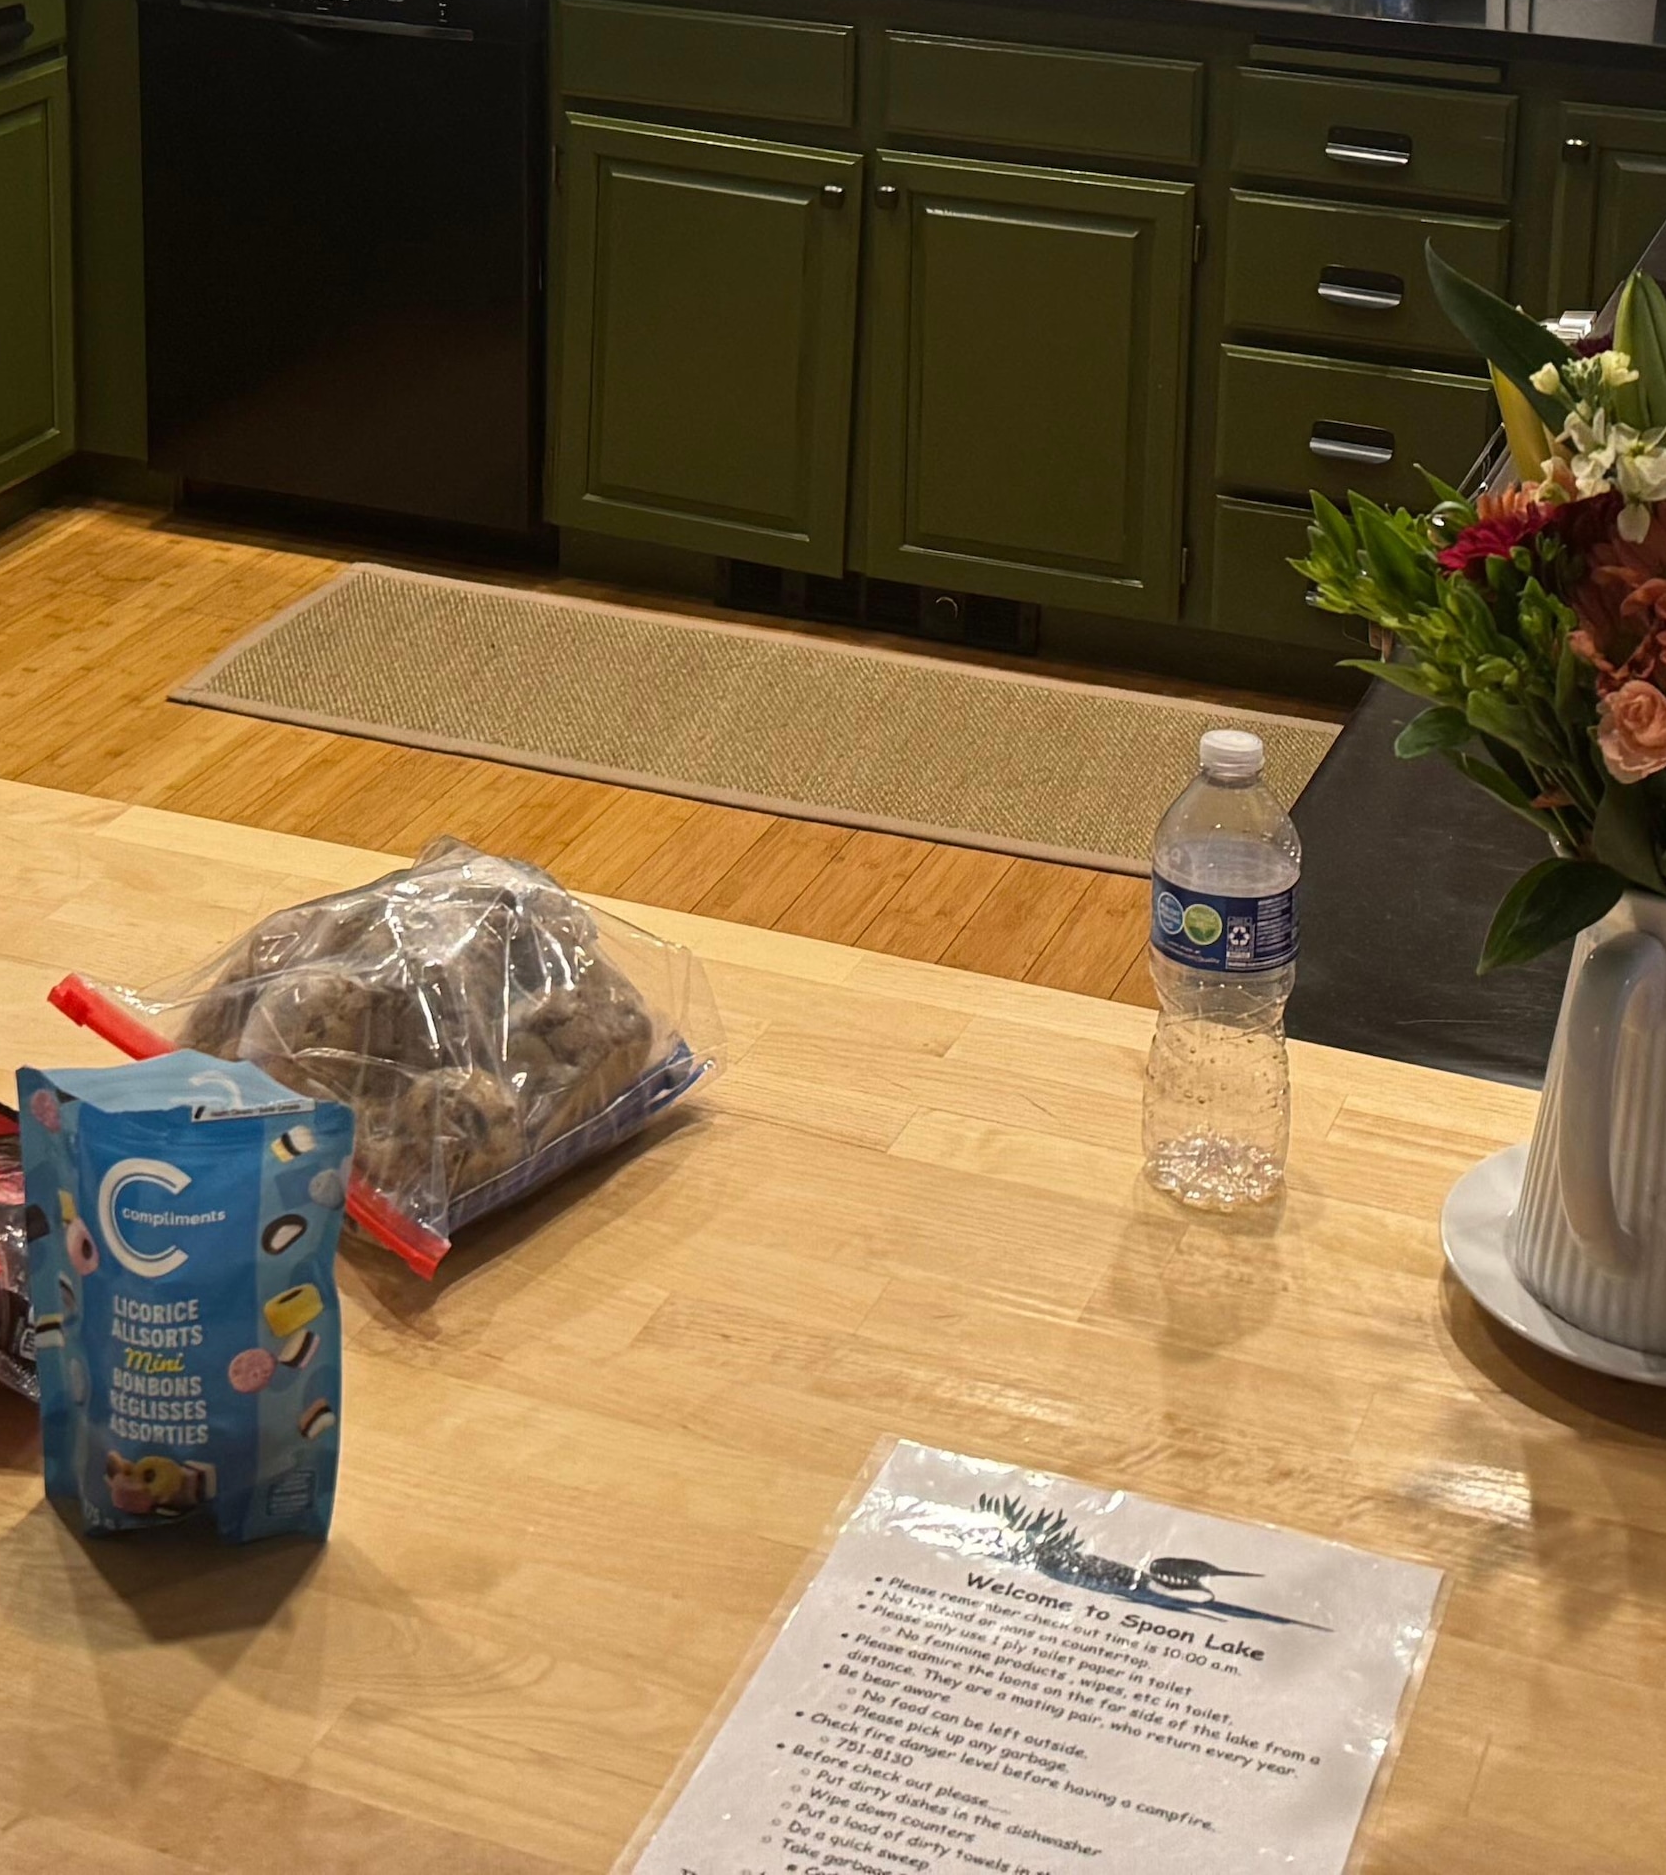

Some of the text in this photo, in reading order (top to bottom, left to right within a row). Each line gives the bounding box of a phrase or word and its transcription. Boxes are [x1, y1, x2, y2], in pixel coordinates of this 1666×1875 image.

[98, 1157, 193, 1279] C
[121, 1205, 227, 1228] compliments
[111, 1316, 204, 1348] ALLSORTS
[113, 1294, 200, 1324] LICORICE
[113, 1367, 203, 1397] BONBONS
[125, 1347, 186, 1374] Mini
[110, 1412, 210, 1445] ASSORTIES
[879, 1589, 903, 1605] No
[976, 1617, 997, 1627] or
[887, 1576, 937, 1598] Please
[1071, 1624, 1101, 1638] out
[1104, 1631, 1139, 1649] time
[1142, 1640, 1159, 1654] is
[966, 1572, 1265, 1661] Welcome to Spoon Lake
[870, 1603, 921, 1625] Please
[922, 1620, 957, 1634] only
[958, 1628, 986, 1643] use
[1001, 1639, 1027, 1653] ply
[1031, 1646, 1076, 1665] toilet
[1076, 1659, 1125, 1678] paper
[1127, 1670, 1144, 1684] in
[1147, 1676, 1193, 1696] toilet
[894, 1626, 920, 1642] No
[923, 1634, 991, 1661] feminine
[993, 1654, 1067, 1681] products
[1131, 1691, 1161, 1706] etc
[1163, 1697, 1180, 1711] in
[836, 1663, 951, 1703] Be bear aware
[853, 1632, 1321, 1766] Please admire the loons on the far side of the lake from a
[851, 1703, 904, 1728] Please
[905, 1721, 942, 1738] pick
[944, 1731, 965, 1745] up
[966, 1738, 997, 1754] any
[861, 1688, 886, 1704] No
[889, 1696, 930, 1716] food
[929, 1709, 960, 1724] can
[961, 1715, 984, 1731] be
[986, 1721, 1021, 1740] left
[924, 1667, 963, 1689] They
[963, 1682, 993, 1697] are
[994, 1690, 1007, 1701] a
[1009, 1694, 1065, 1717] mating
[1108, 1721, 1142, 1737] who
[1145, 1731, 1201, 1753] return
[1204, 1747, 1253, 1767] every
[790, 1743, 933, 1792] Before check out
[809, 1711, 860, 1734] Check
[862, 1726, 896, 1744] fire
[898, 1737, 956, 1759] danger
[958, 1751, 999, 1772] level
[1001, 1763, 1059, 1789] before
[1062, 1780, 1117, 1807] having
[1119, 1798, 1132, 1809] a
[835, 1736, 913, 1767] 751-8130
[786, 1818, 874, 1853] Do a quick
[794, 1801, 826, 1820] Put
[825, 1814, 840, 1825] a
[842, 1815, 881, 1836] load
[880, 1829, 905, 1842] of
[905, 1835, 951, 1856] dirty
[955, 1848, 1011, 1873] towels
[808, 1786, 976, 1843] Wipe down counters
[815, 1768, 1102, 1856] Put dirty dishes in the dishwasher
[781, 1836, 820, 1860] Take
